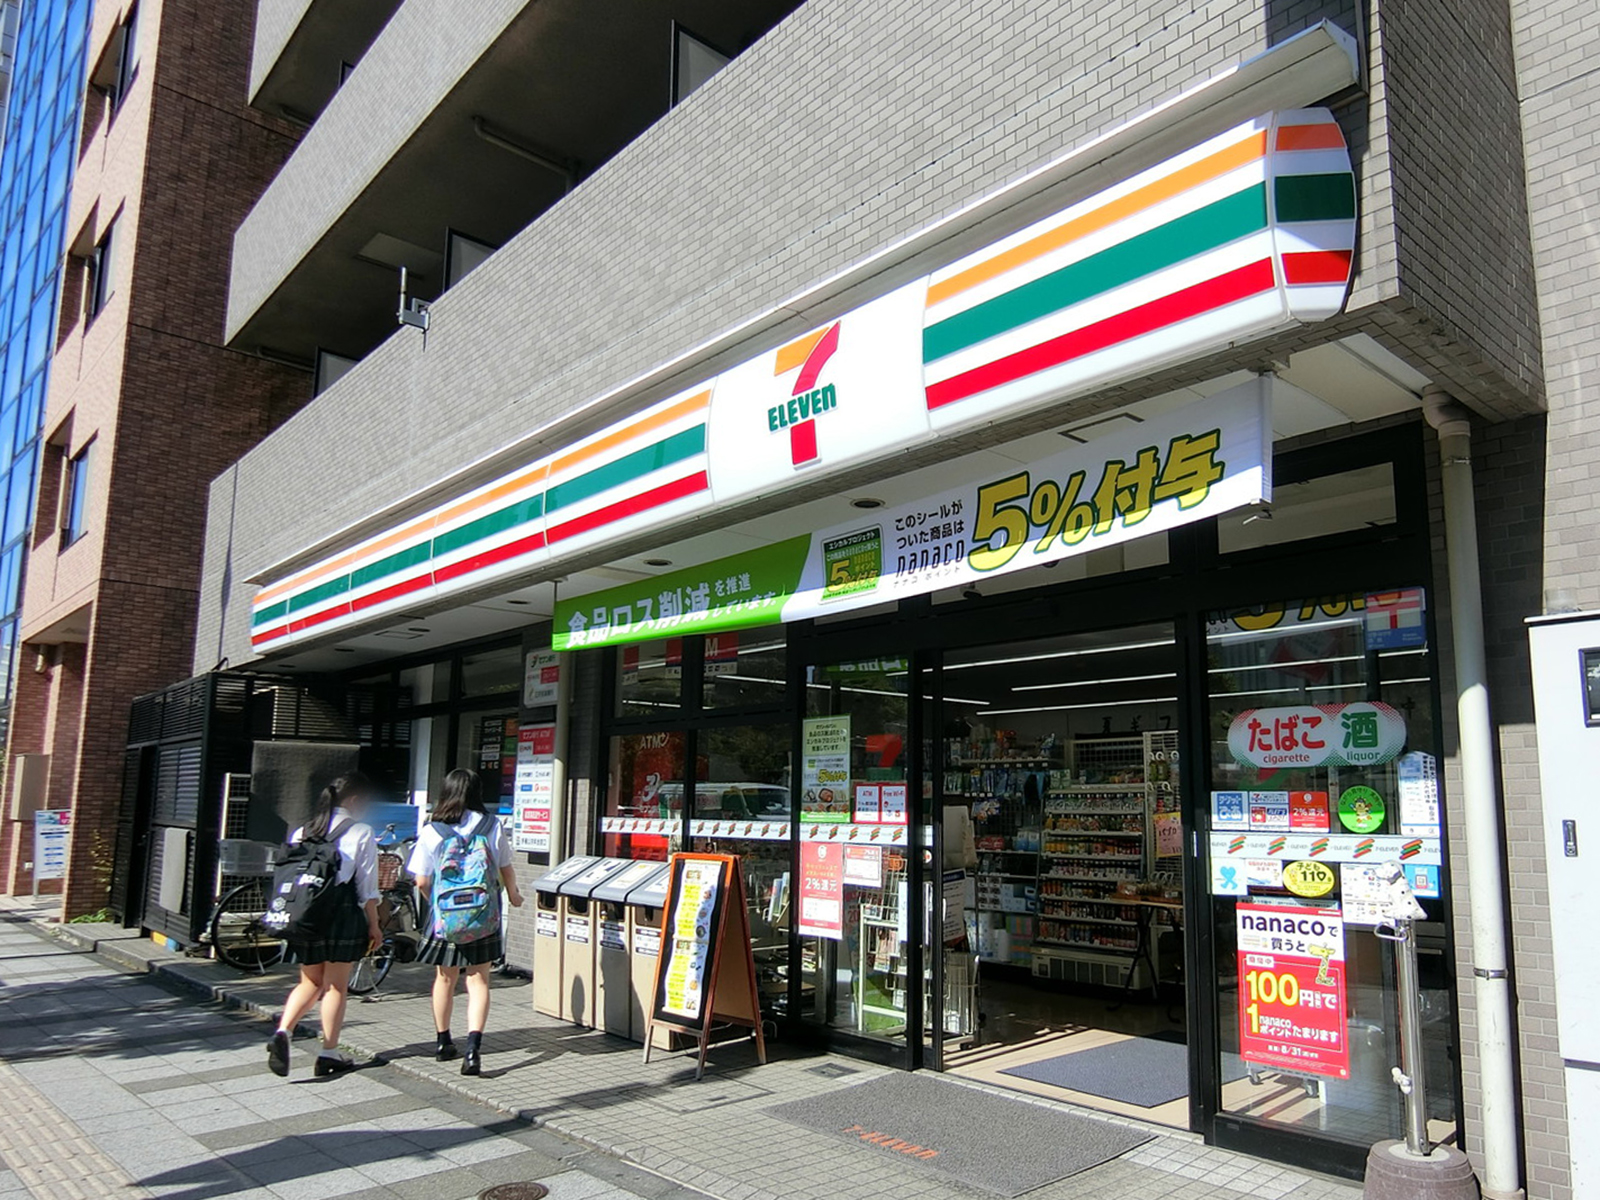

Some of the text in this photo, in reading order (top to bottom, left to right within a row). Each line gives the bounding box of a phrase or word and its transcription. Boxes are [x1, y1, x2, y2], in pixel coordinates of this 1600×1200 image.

[895, 499, 963, 531] このシールが
[967, 428, 1226, 572] 5%付与
[897, 519, 964, 549] ついた商品は
[896, 539, 964, 578] nanaco
[714, 572, 751, 597] を推進
[566, 583, 711, 649] 食品ロス削減
[640, 734, 661, 749] ATM
[1248, 711, 1378, 752] たばこ 酒
[1263, 751, 1380, 764] cigarette liquor
[1271, 937, 1306, 953] 買うと
[1246, 1003, 1260, 1034] 1
[1259, 1015, 1292, 1029] nanaco
[1259, 1025, 1339, 1043] ポイント たまります
